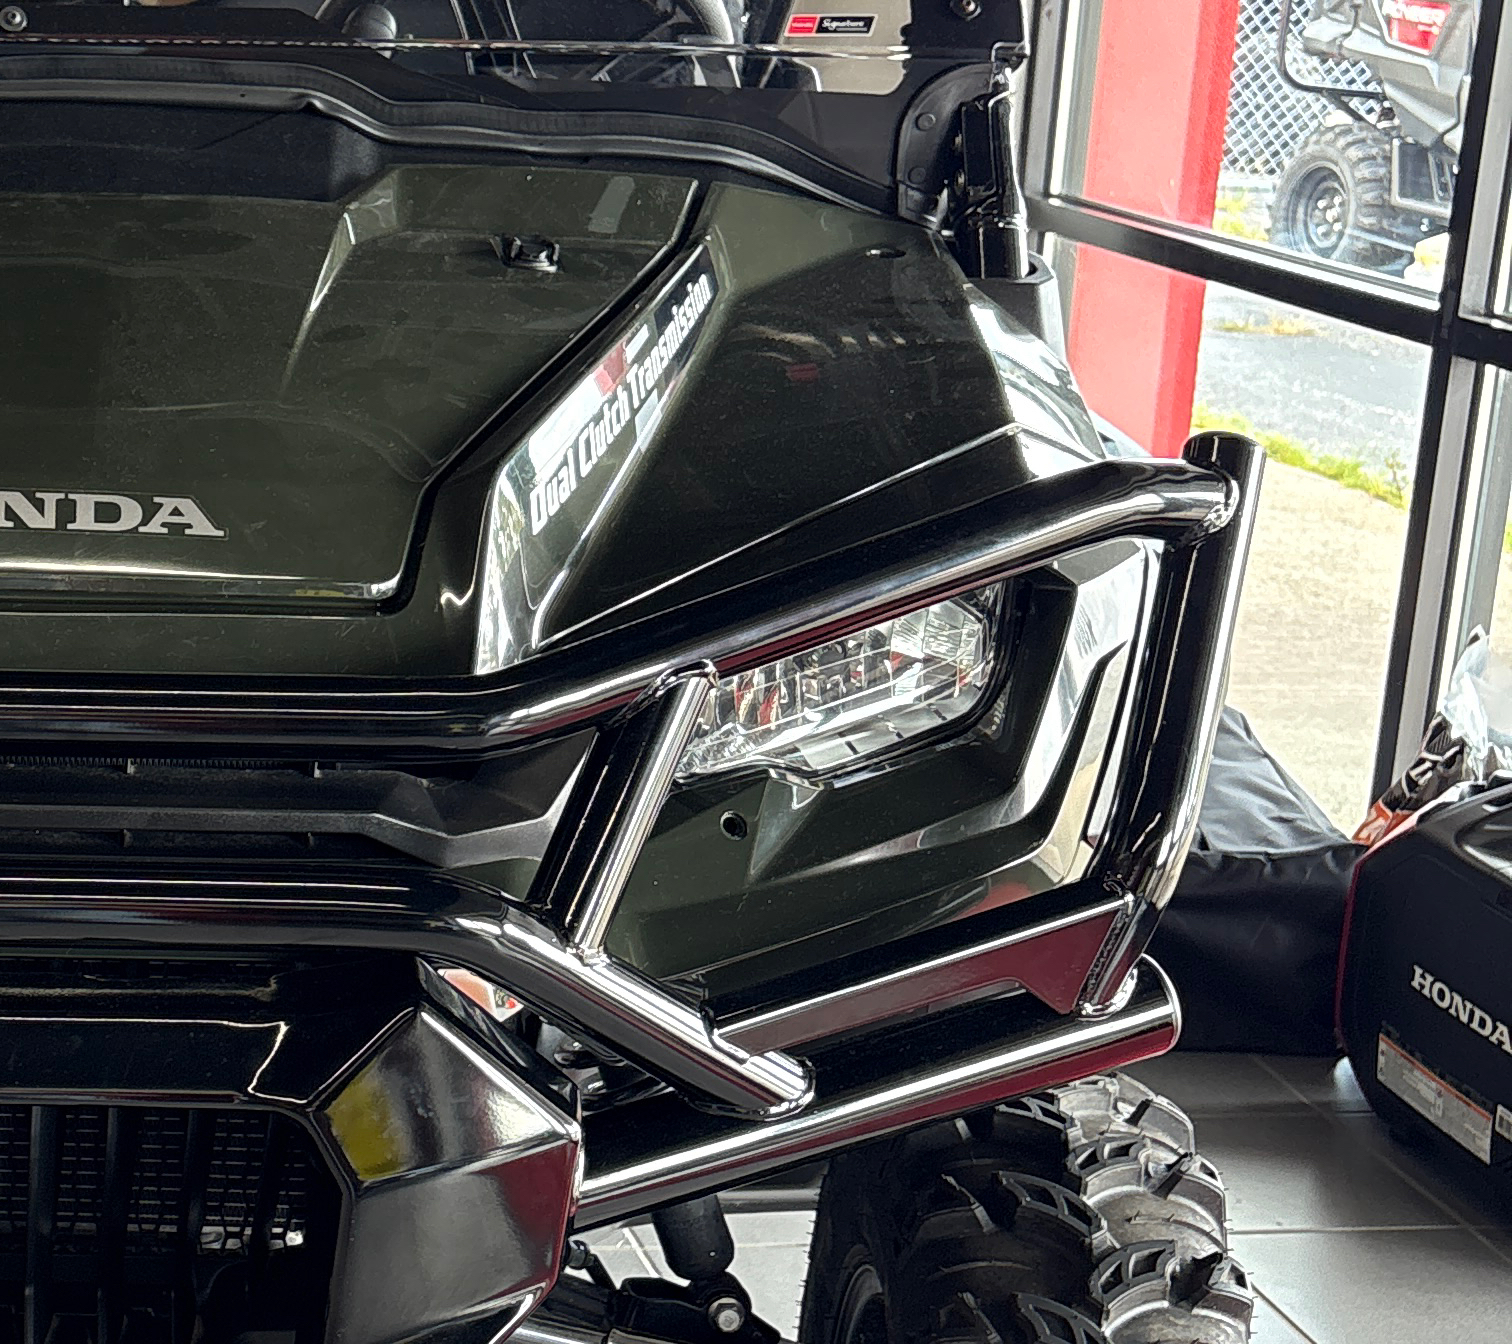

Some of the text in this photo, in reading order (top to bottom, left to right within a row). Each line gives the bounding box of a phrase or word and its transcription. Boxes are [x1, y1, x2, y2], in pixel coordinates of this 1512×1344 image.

[529, 273, 712, 536] Dual Clutch Transmission
[1410, 964, 1512, 1055] HONDA
